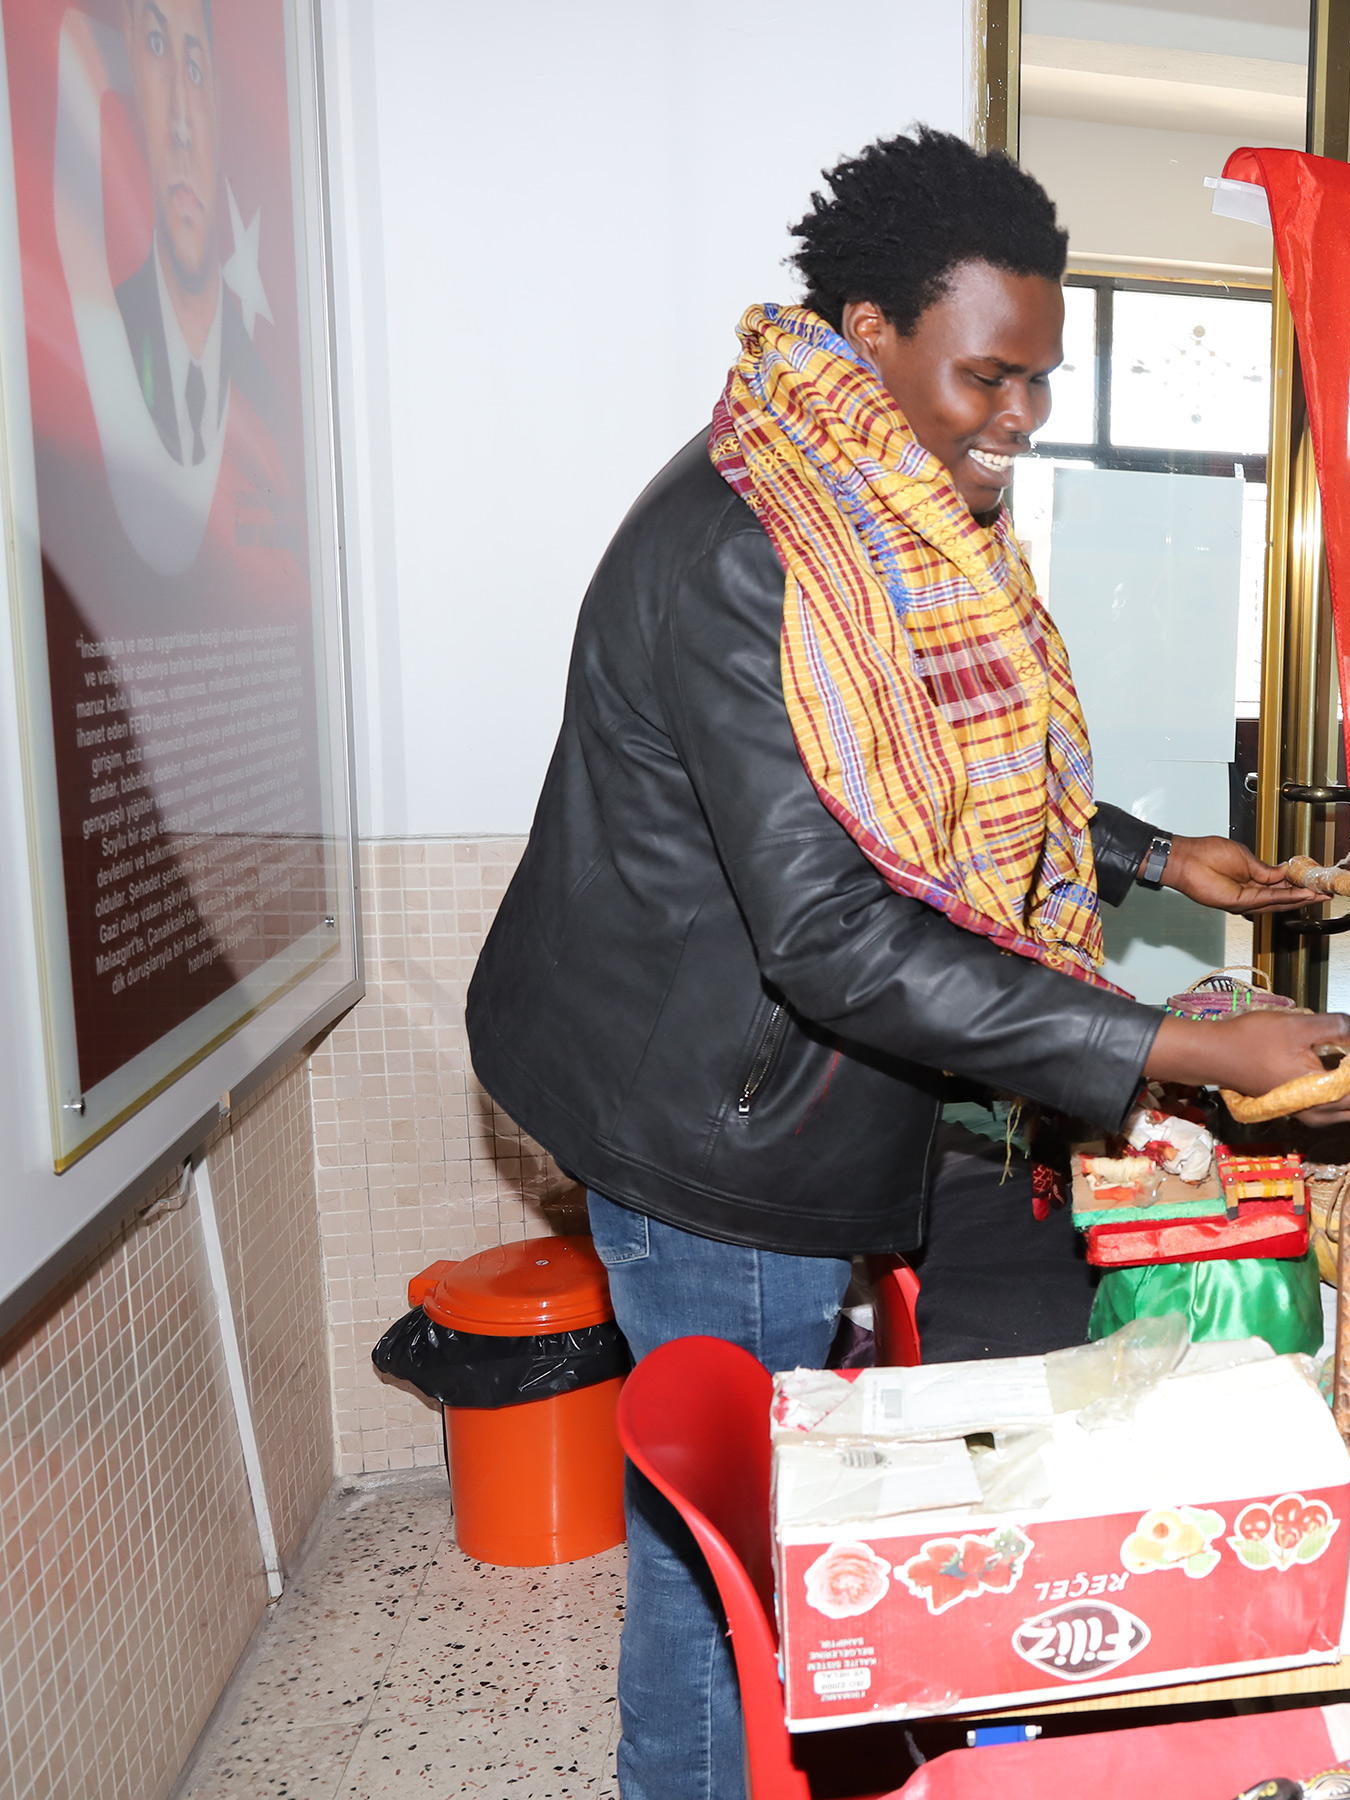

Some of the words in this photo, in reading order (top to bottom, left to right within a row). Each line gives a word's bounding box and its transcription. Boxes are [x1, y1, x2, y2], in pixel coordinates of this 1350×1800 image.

[84, 671, 97, 687] ve
[77, 698, 106, 718] maruz
[77, 725, 106, 748] ihanet
[107, 720, 129, 741] eden
[126, 743, 143, 765] aziz
[101, 832, 127, 857] Soylu
[127, 826, 139, 848] bir
[134, 855, 145, 871] ve
[99, 917, 120, 945] Gazi
[120, 911, 140, 933] olup
[140, 900, 163, 923] vatan
[112, 971, 126, 995] dik
[173, 937, 184, 959] bir
[184, 933, 198, 952] kez
[1034, 1571, 1130, 1602] REÇEL
[1019, 1607, 1138, 1667] Filiz
